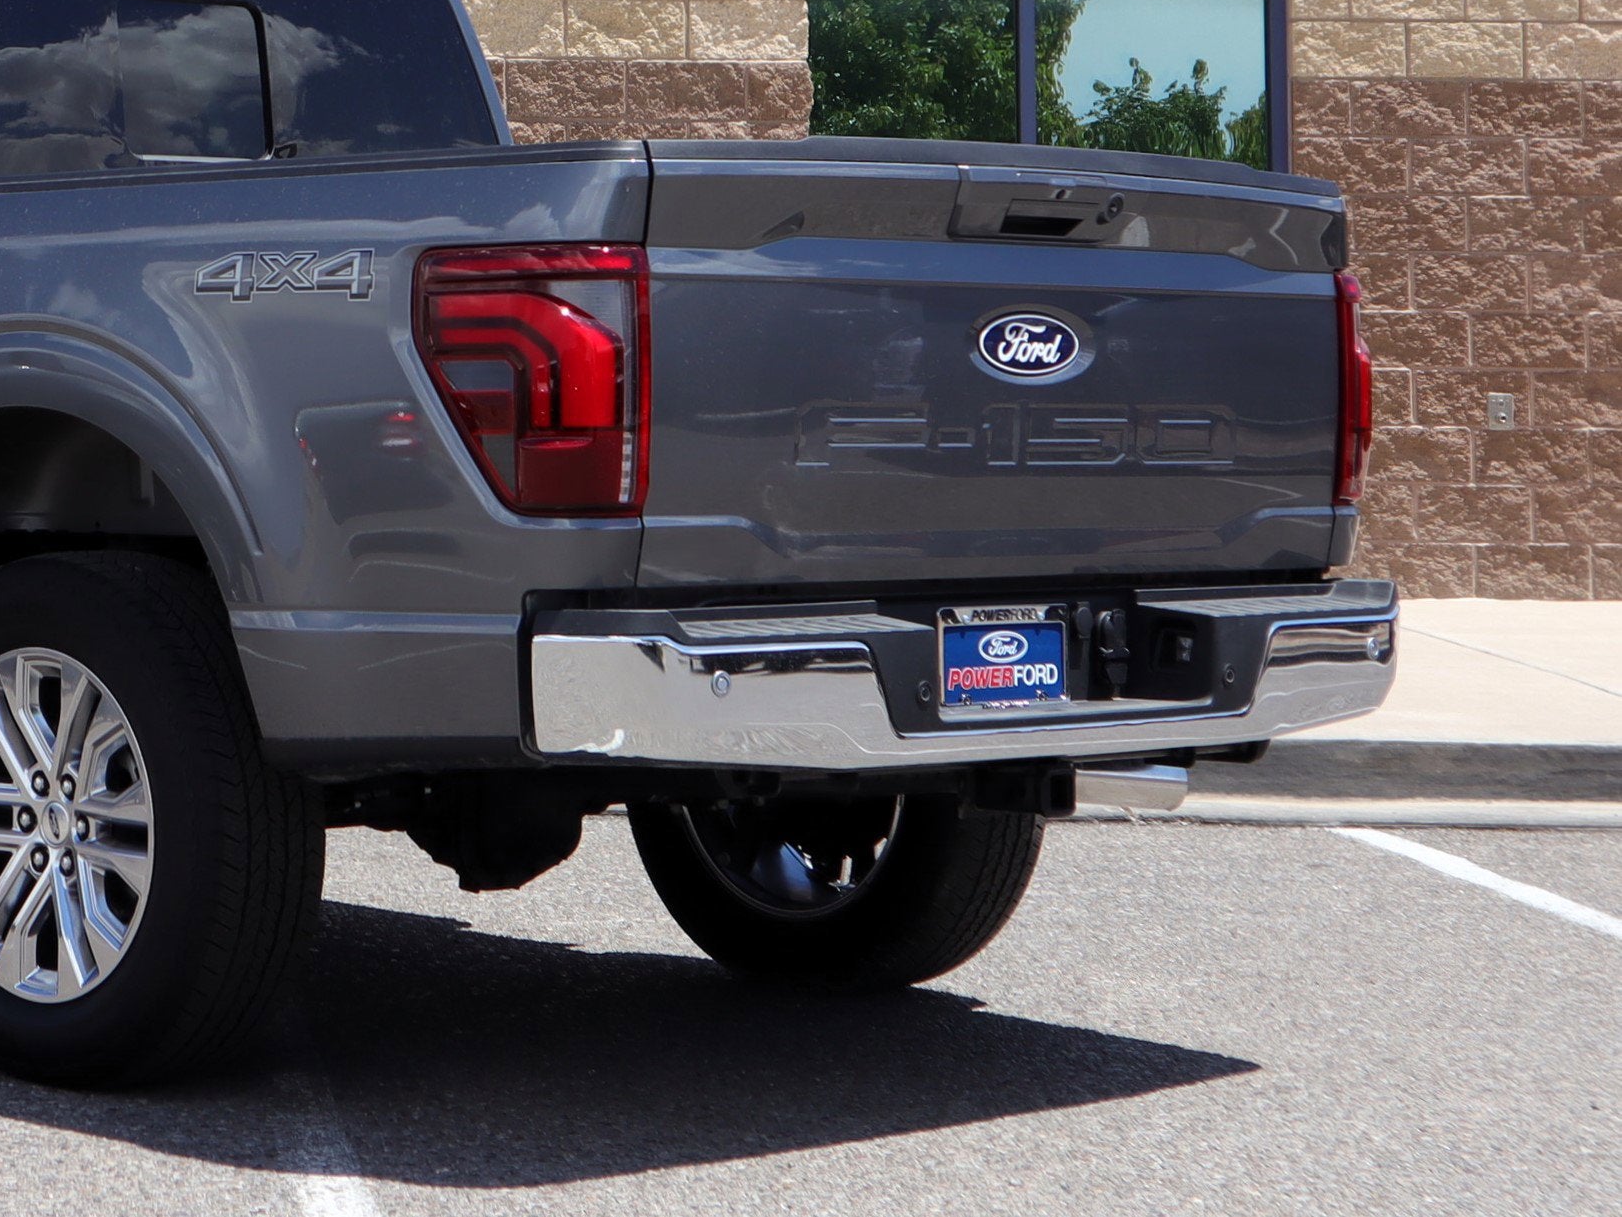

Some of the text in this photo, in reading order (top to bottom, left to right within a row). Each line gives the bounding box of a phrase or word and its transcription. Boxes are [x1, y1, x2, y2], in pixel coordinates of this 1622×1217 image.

[996, 322, 1062, 364] Ford
[795, 401, 1236, 467] F-150
[971, 608, 1037, 622] POWERFORD
[987, 637, 1018, 656] Ford
[948, 663, 1059, 691] POWERFORD
